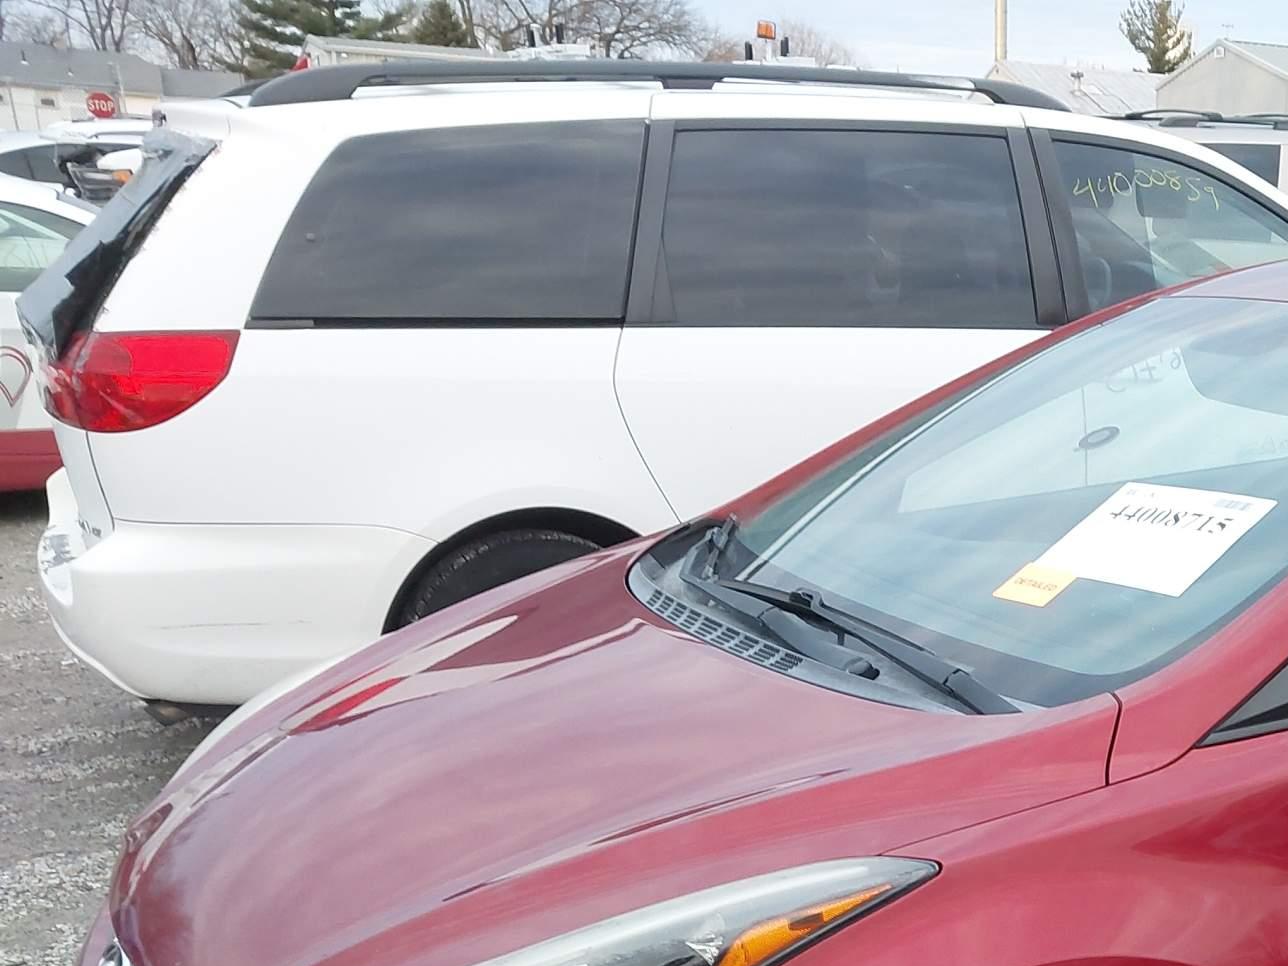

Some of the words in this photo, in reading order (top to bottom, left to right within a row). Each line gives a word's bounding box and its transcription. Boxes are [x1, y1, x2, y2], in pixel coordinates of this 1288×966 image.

[88, 100, 114, 112] STOP
[1072, 169, 1220, 210] 44000859
[1109, 504, 1235, 534] 44008715
